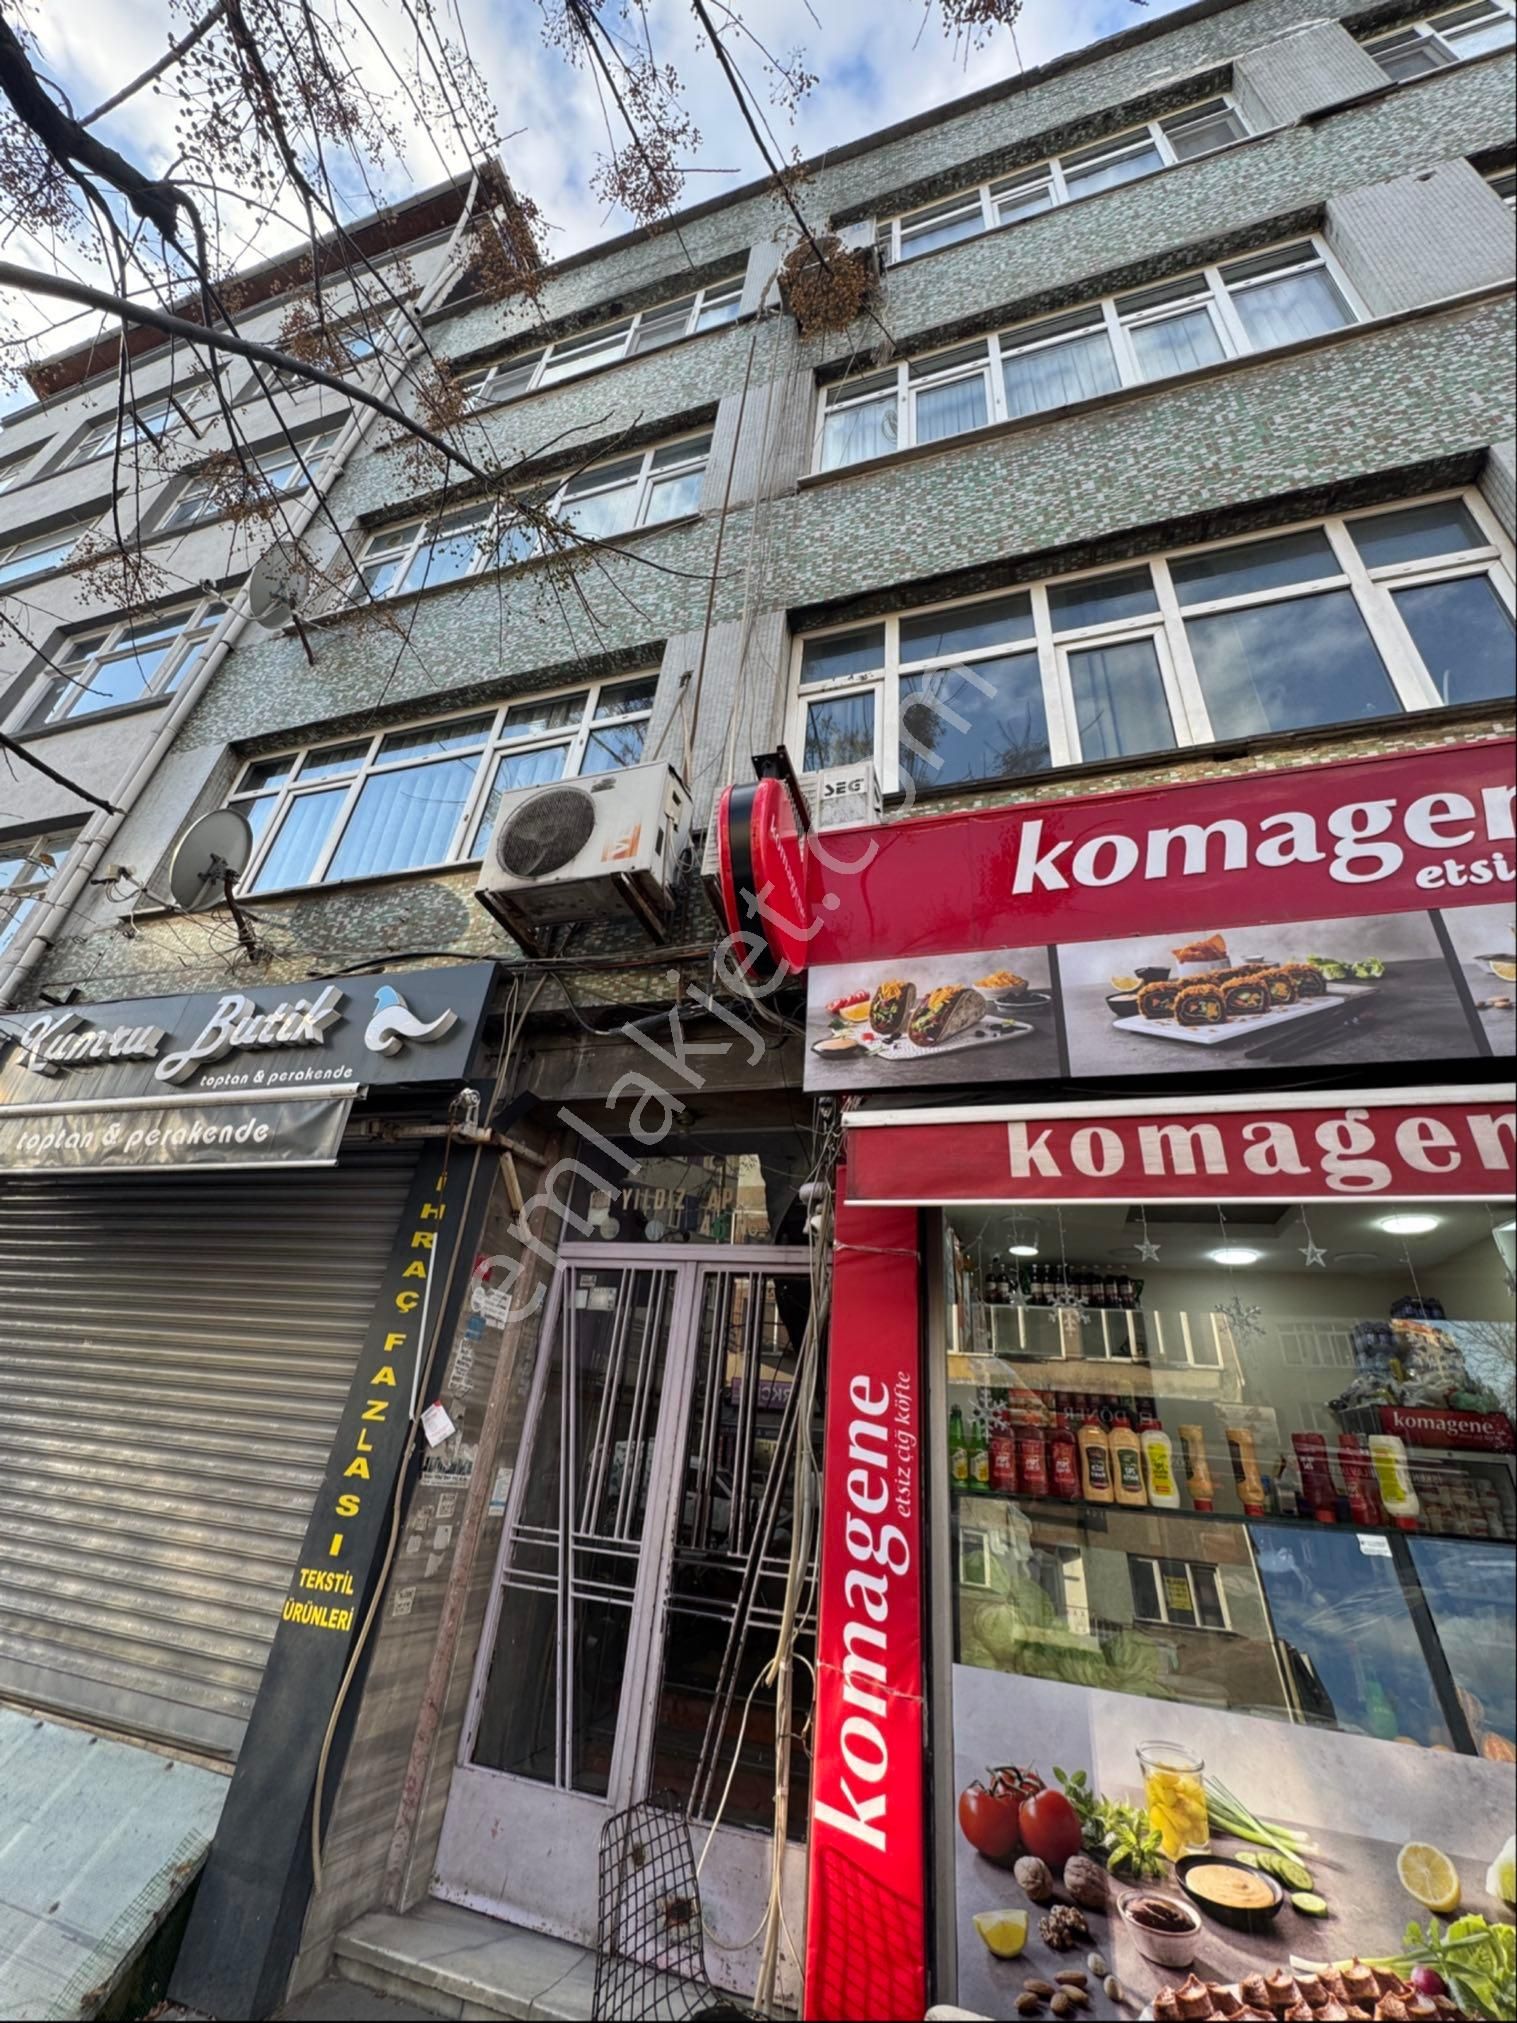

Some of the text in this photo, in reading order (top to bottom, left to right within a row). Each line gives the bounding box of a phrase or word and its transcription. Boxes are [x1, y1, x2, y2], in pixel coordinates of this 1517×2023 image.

[824, 778, 864, 797] SEG
[155, 984, 344, 1083] Butik
[200, 1065, 353, 1089] toptan & perakende
[16, 1117, 270, 1155] toptan & perakende
[622, 1188, 687, 1211] YILDIZ
[1393, 1411, 1495, 1437] komagene
[893, 1371, 917, 1518] etsiz çiğ köfte
[299, 1568, 354, 1596] TEKSTİL
[283, 1597, 355, 1632] ÜRÜNLERİ
[814, 1375, 910, 1852] komagene
